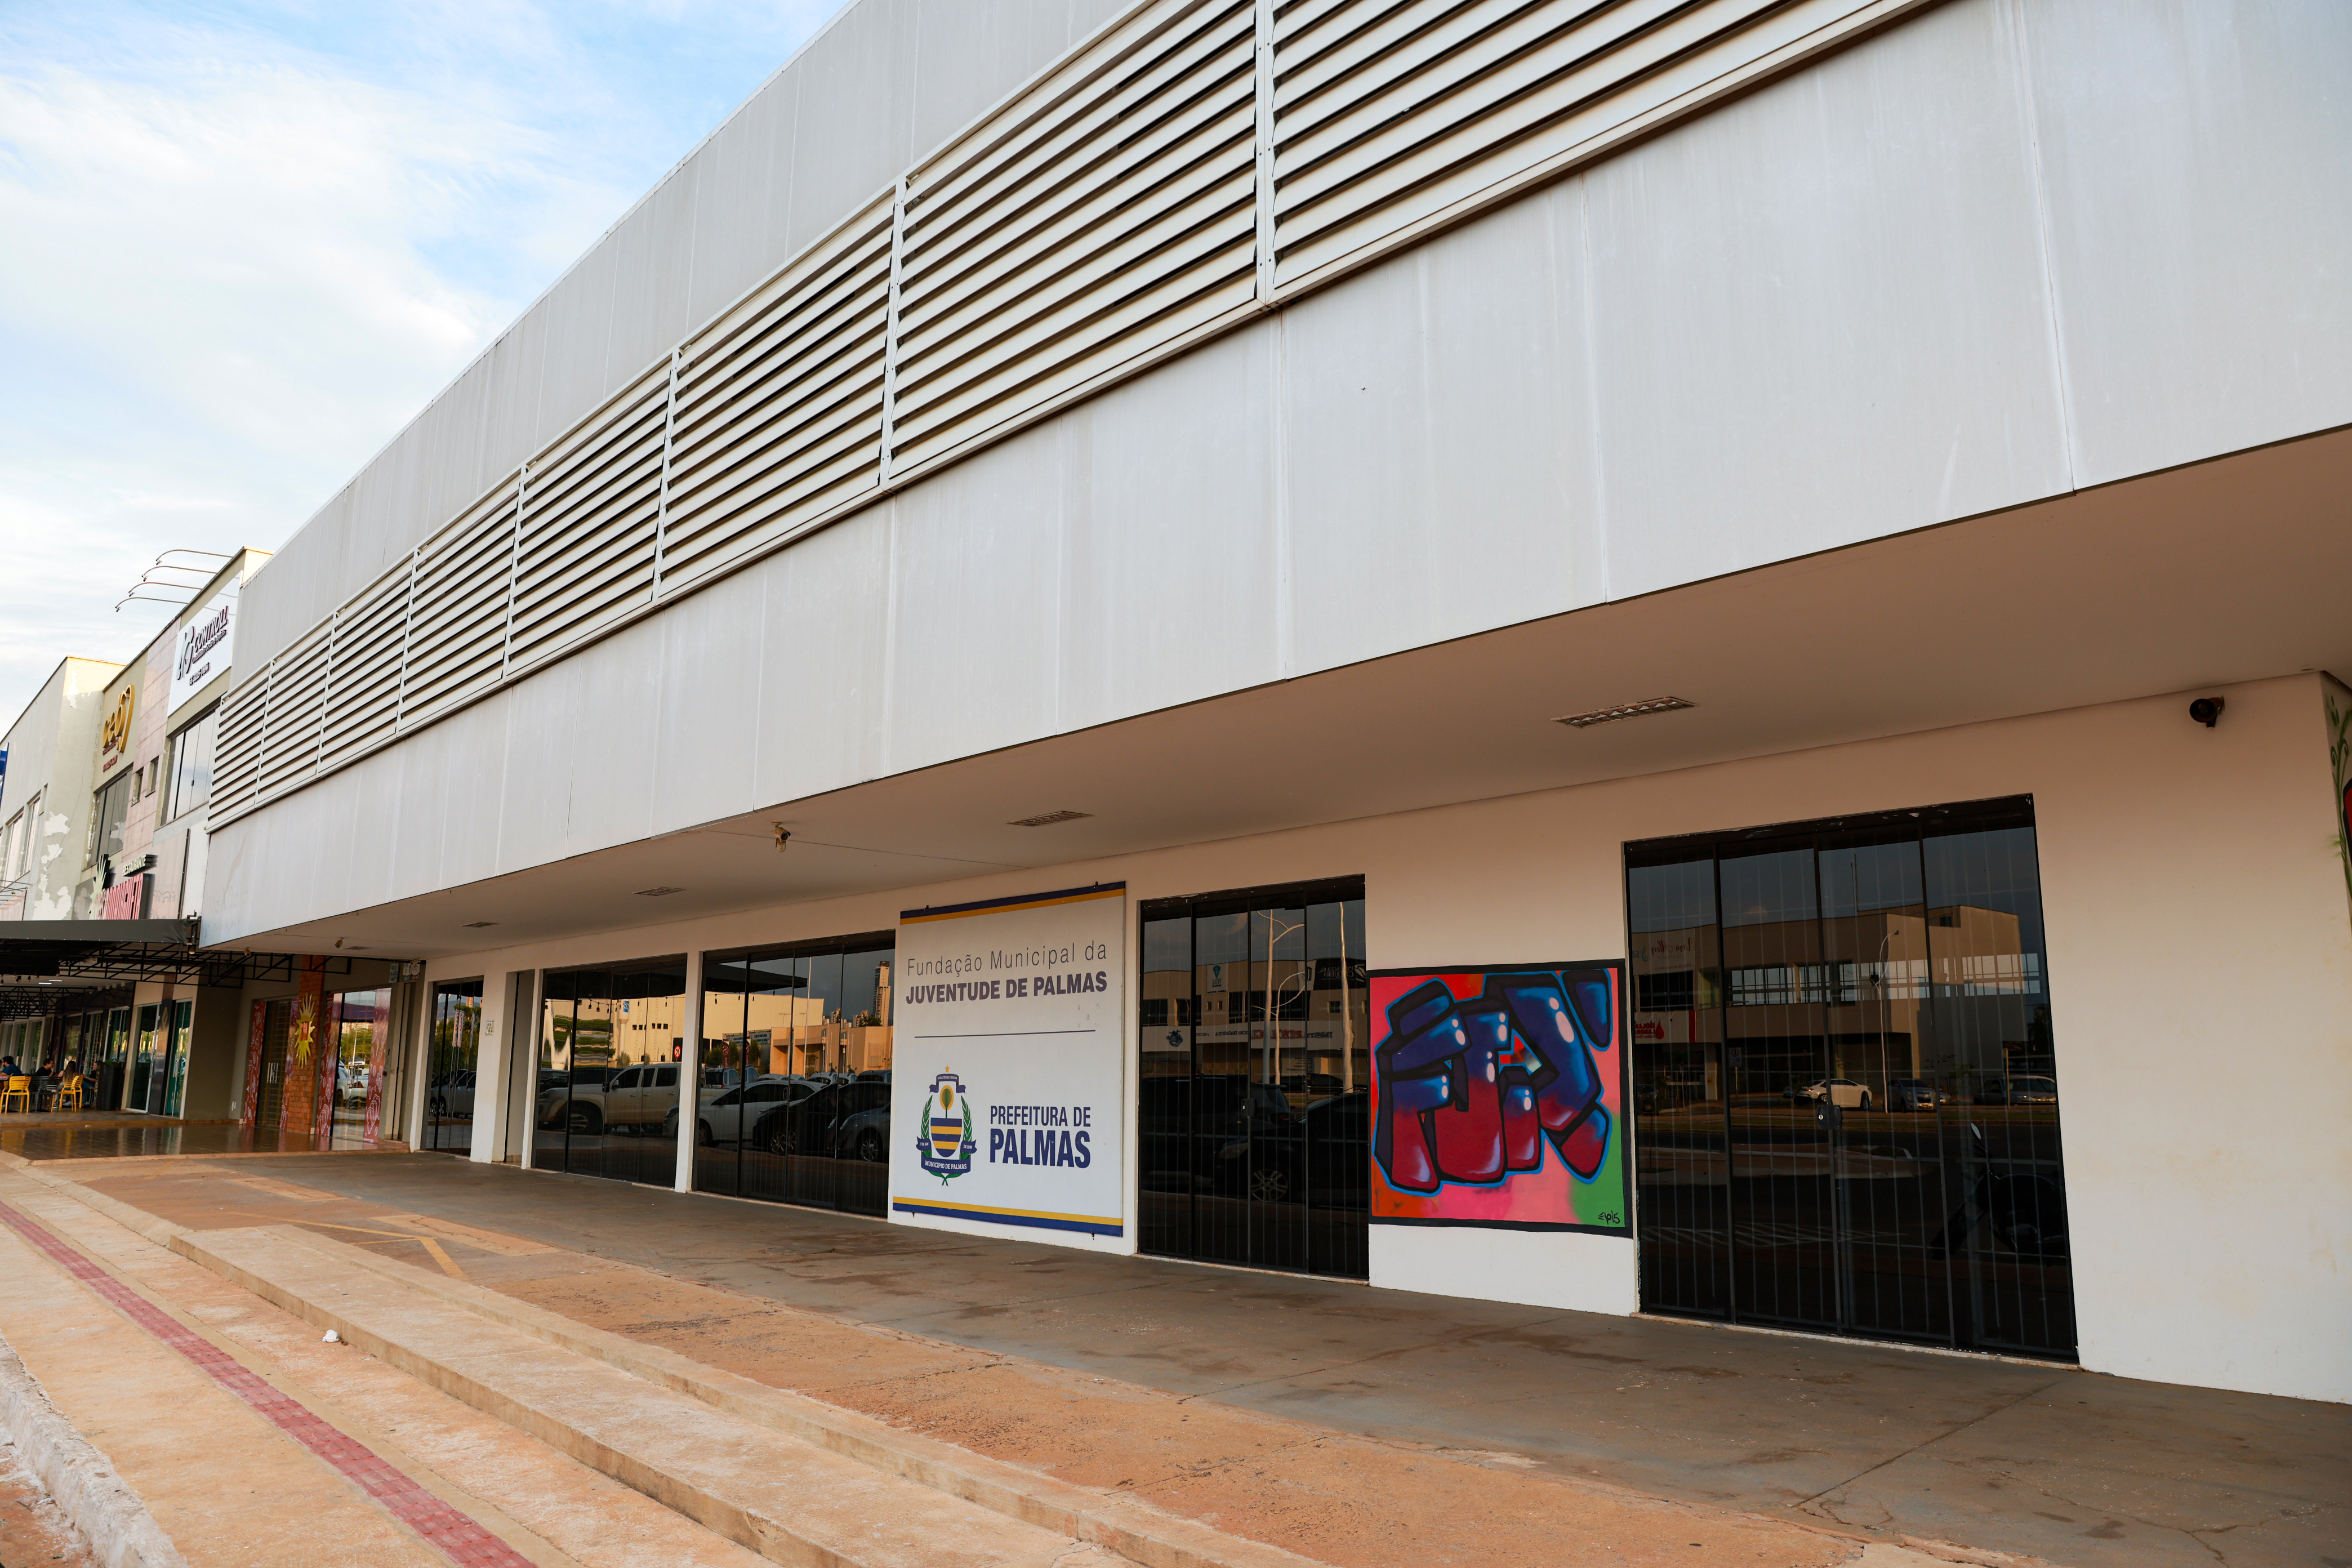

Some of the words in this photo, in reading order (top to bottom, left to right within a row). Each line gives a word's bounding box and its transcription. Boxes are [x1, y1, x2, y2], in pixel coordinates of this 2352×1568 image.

[195, 605, 228, 653] CONTROLL
[122, 854, 146, 876] RESTAURANTE
[908, 954, 982, 977] Fundação
[991, 942, 1074, 969] Municipal
[1085, 941, 1106, 960] da
[906, 980, 1000, 1004] JUVENTUDE
[1006, 978, 1027, 998] DE
[1034, 971, 1107, 996] PALMAS
[991, 1106, 1068, 1126] PREFEITURA
[1073, 1107, 1090, 1127] DE
[925, 1160, 945, 1169] MUNICÍPIO
[990, 1128, 1090, 1168] PALMAS
